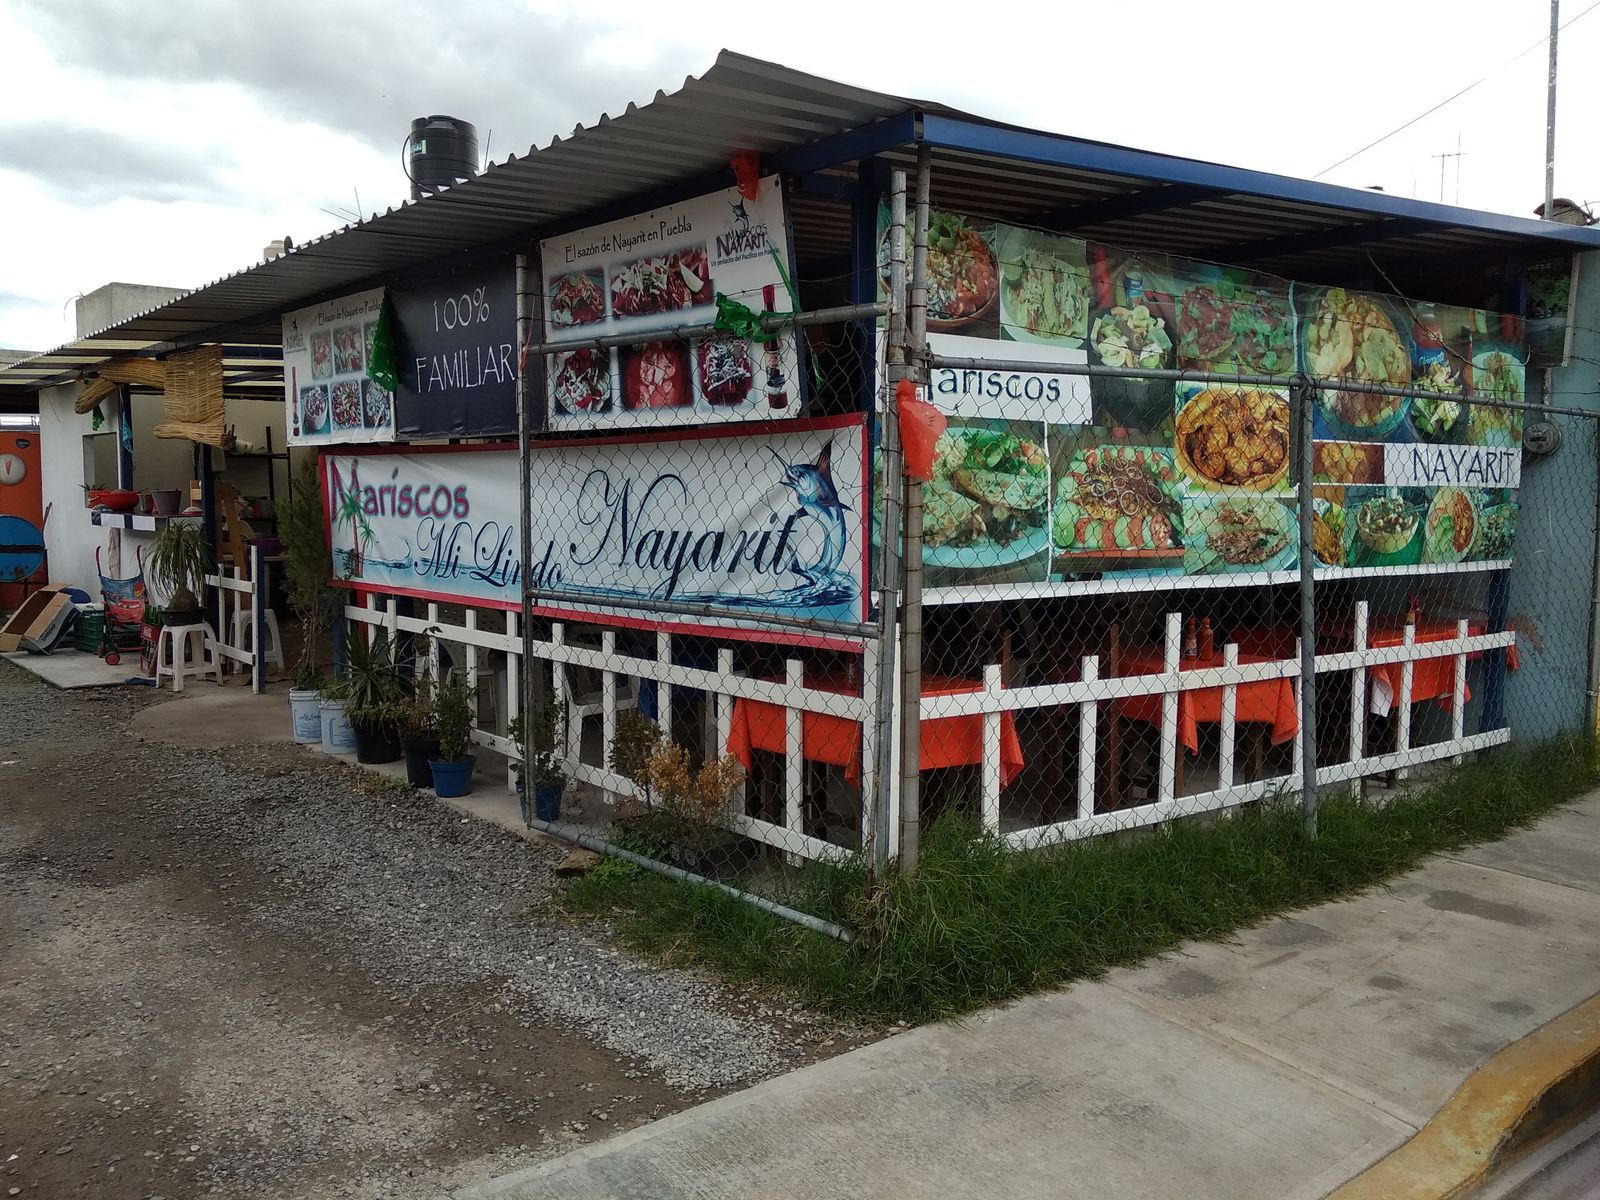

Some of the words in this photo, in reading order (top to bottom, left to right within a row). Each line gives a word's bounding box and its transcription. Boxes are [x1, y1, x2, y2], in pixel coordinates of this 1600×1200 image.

[565, 243, 577, 263] El
[577, 243, 600, 258] sazón
[601, 236, 611, 253] de
[612, 232, 646, 253] Nayarit
[647, 230, 659, 241] en
[660, 216, 692, 240] Puebla
[716, 232, 766, 258] NAYARIT
[433, 286, 490, 333] 100%
[416, 343, 516, 394] FAMILIAR
[330, 456, 470, 520] Mariscos
[1413, 447, 1515, 484] NAYARIT
[414, 517, 472, 580] Mi
[470, 520, 565, 590] Lindo
[570, 470, 797, 602] Nayarit
